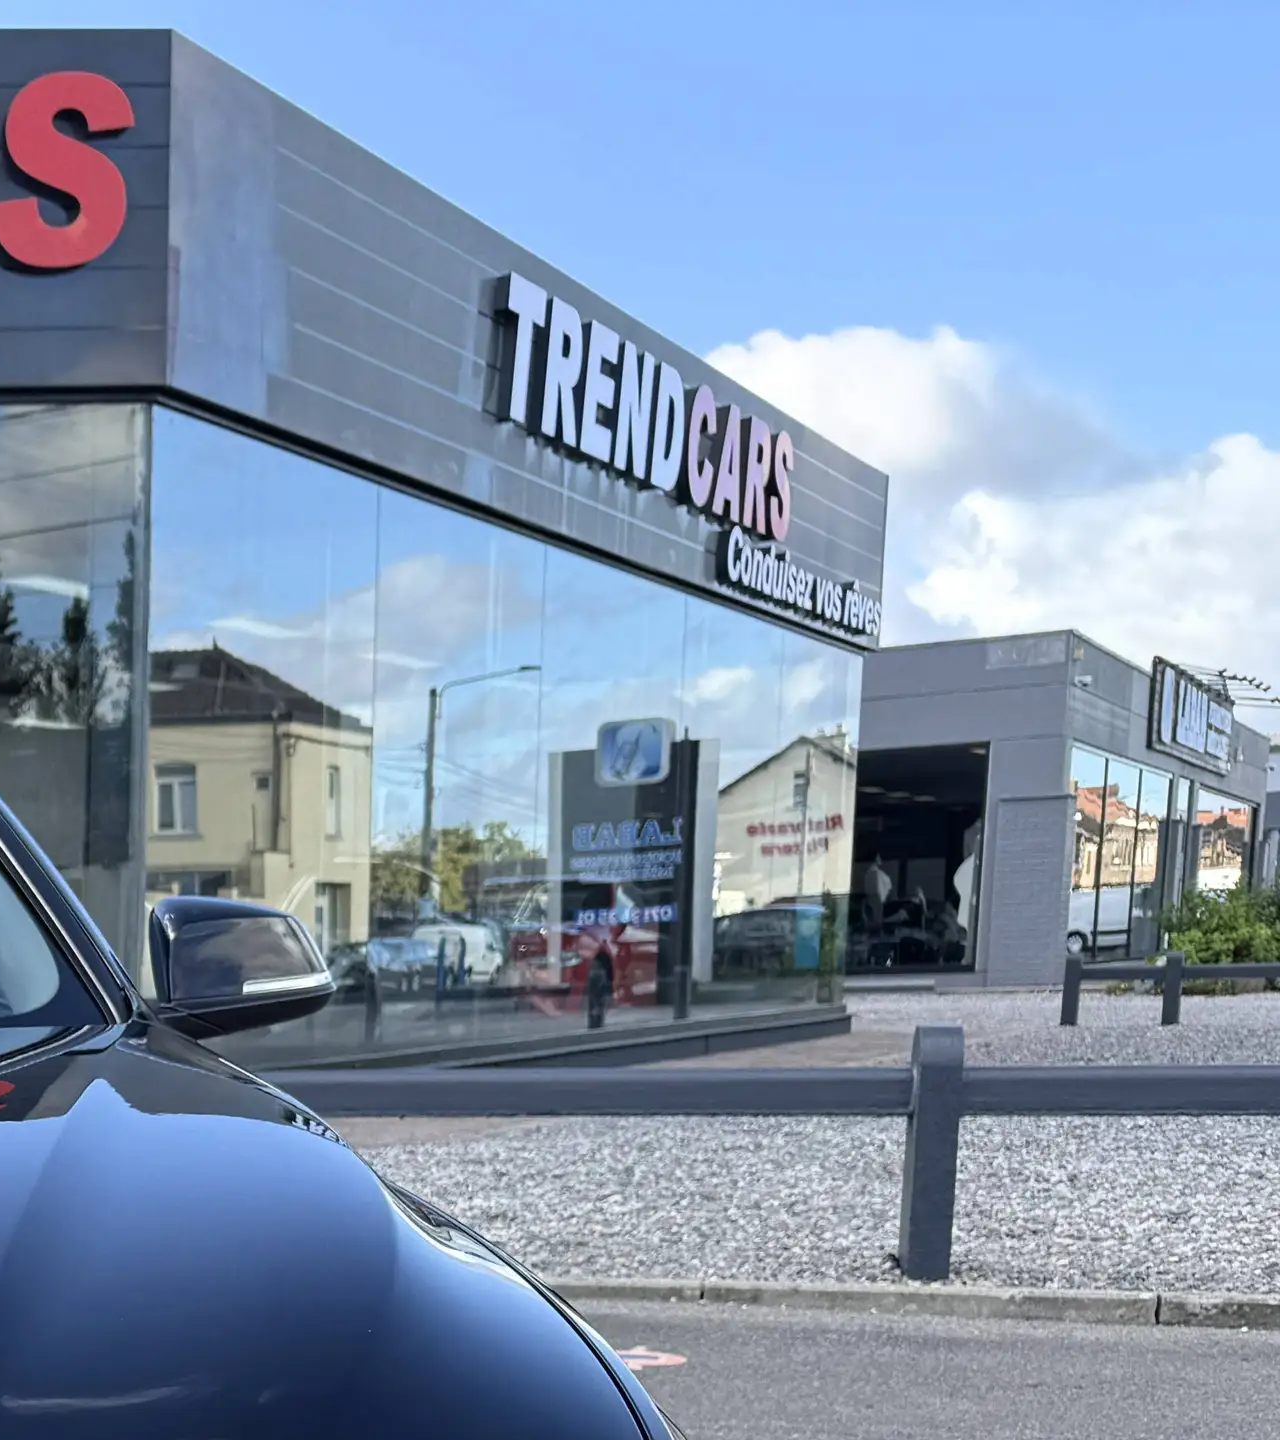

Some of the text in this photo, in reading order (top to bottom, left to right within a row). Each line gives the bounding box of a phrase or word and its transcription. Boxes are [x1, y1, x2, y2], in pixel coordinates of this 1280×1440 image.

[508, 271, 794, 542] TREND CARS
[727, 525, 882, 637] Conduisez vos rêves
